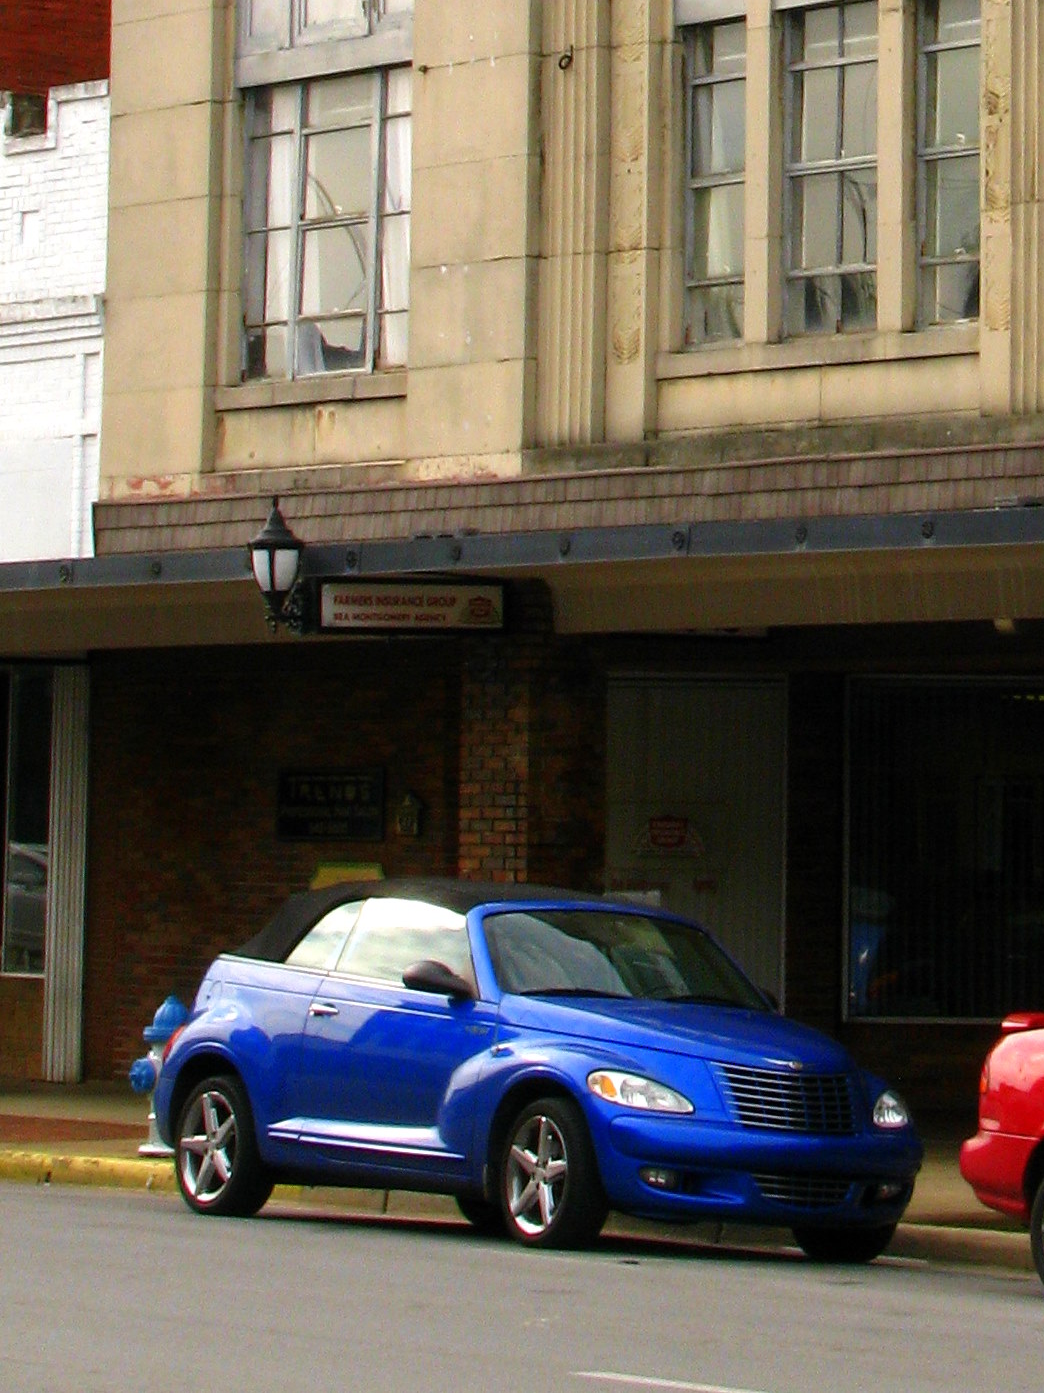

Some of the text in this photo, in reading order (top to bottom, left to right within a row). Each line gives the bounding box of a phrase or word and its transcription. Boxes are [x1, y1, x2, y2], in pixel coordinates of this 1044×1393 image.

[333, 595, 373, 607] FARMERS
[375, 595, 423, 607] INSURANCE
[426, 595, 456, 607] GROUP
